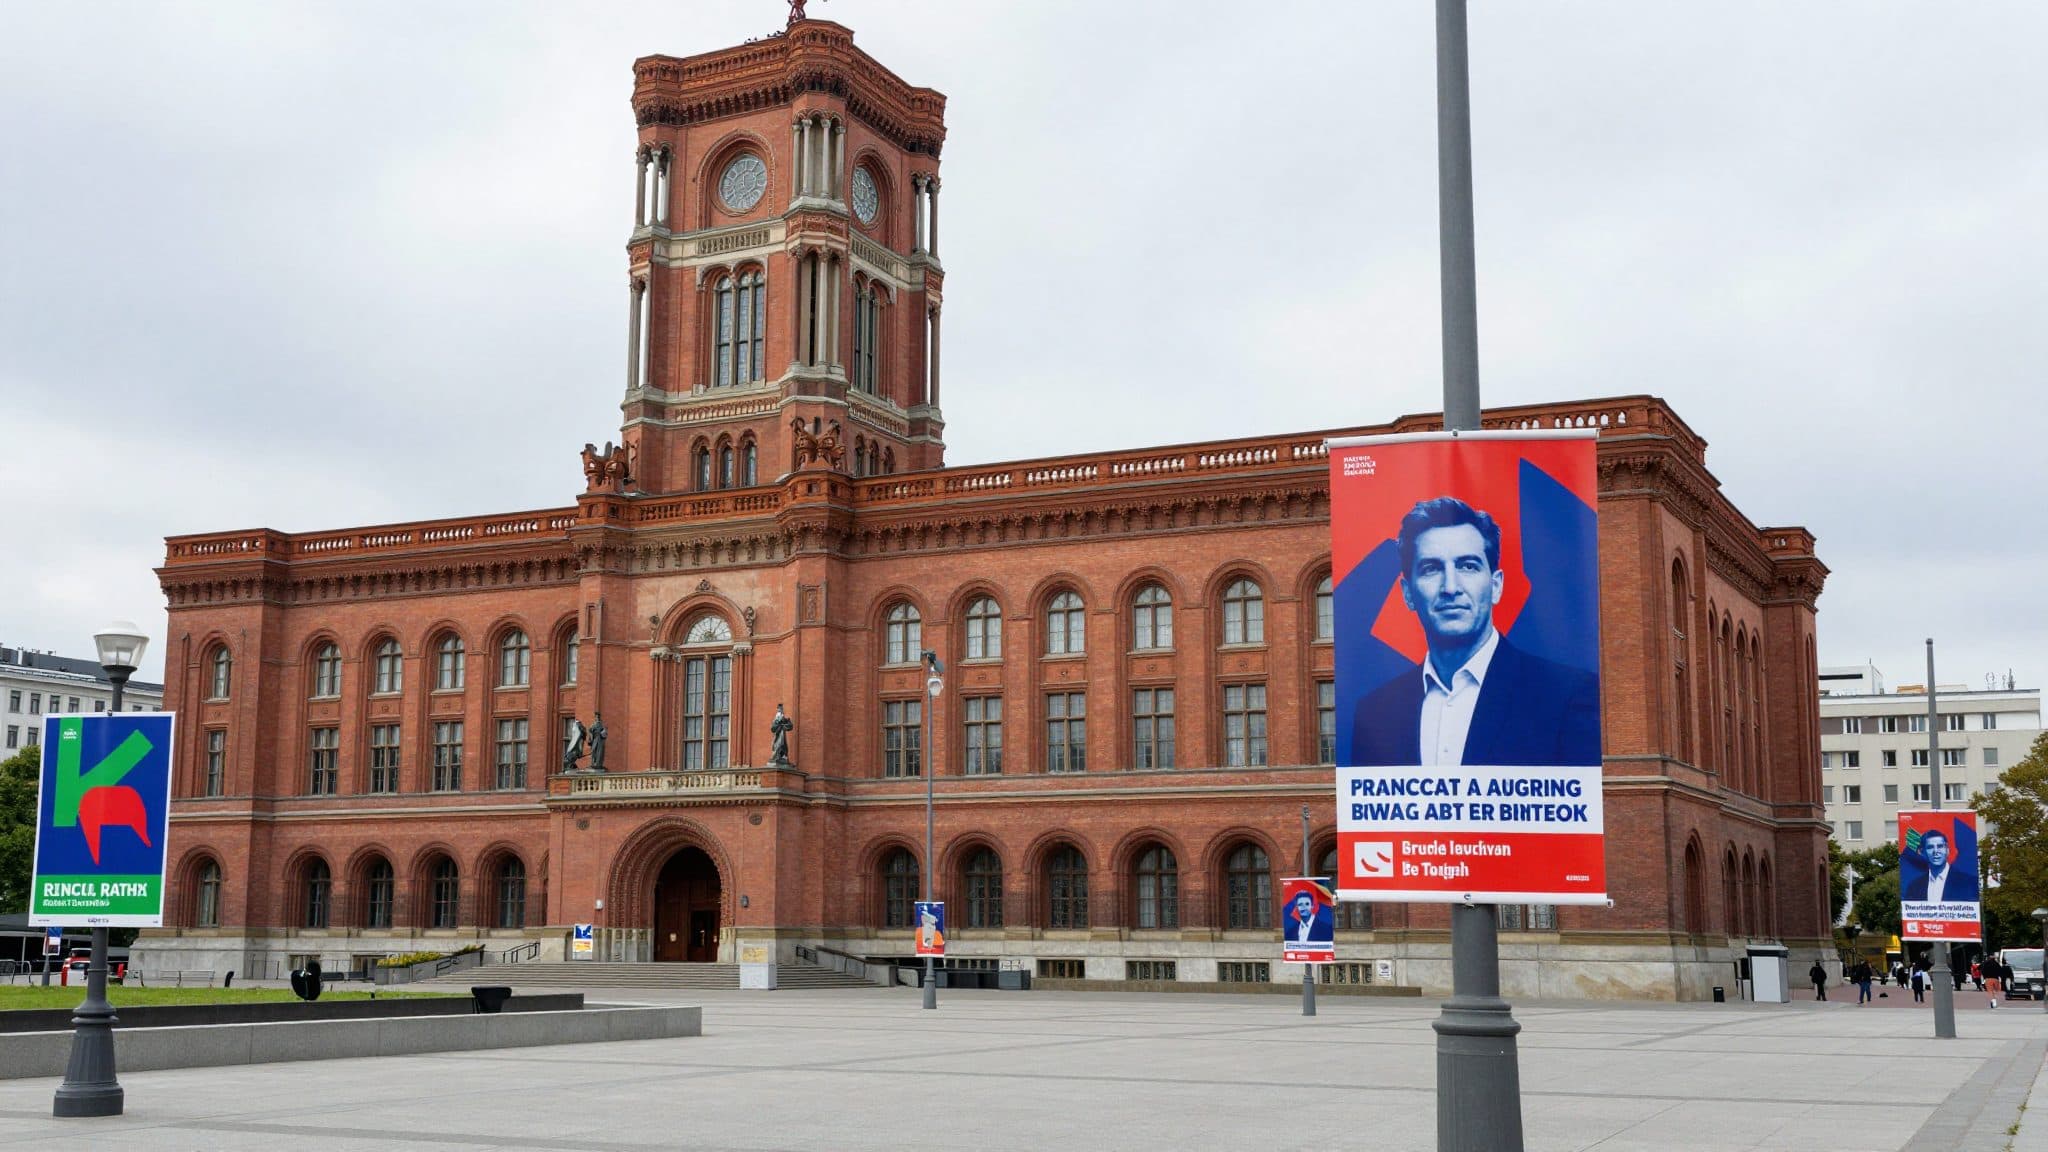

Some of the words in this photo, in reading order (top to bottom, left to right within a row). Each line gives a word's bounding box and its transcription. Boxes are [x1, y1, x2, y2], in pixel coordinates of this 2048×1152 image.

[1351, 778, 1461, 797] PRANCCAT
[1467, 778, 1482, 796] A
[1487, 778, 1582, 798] AUGRING
[1425, 802, 1464, 821] ABT
[1469, 803, 1495, 821] ER
